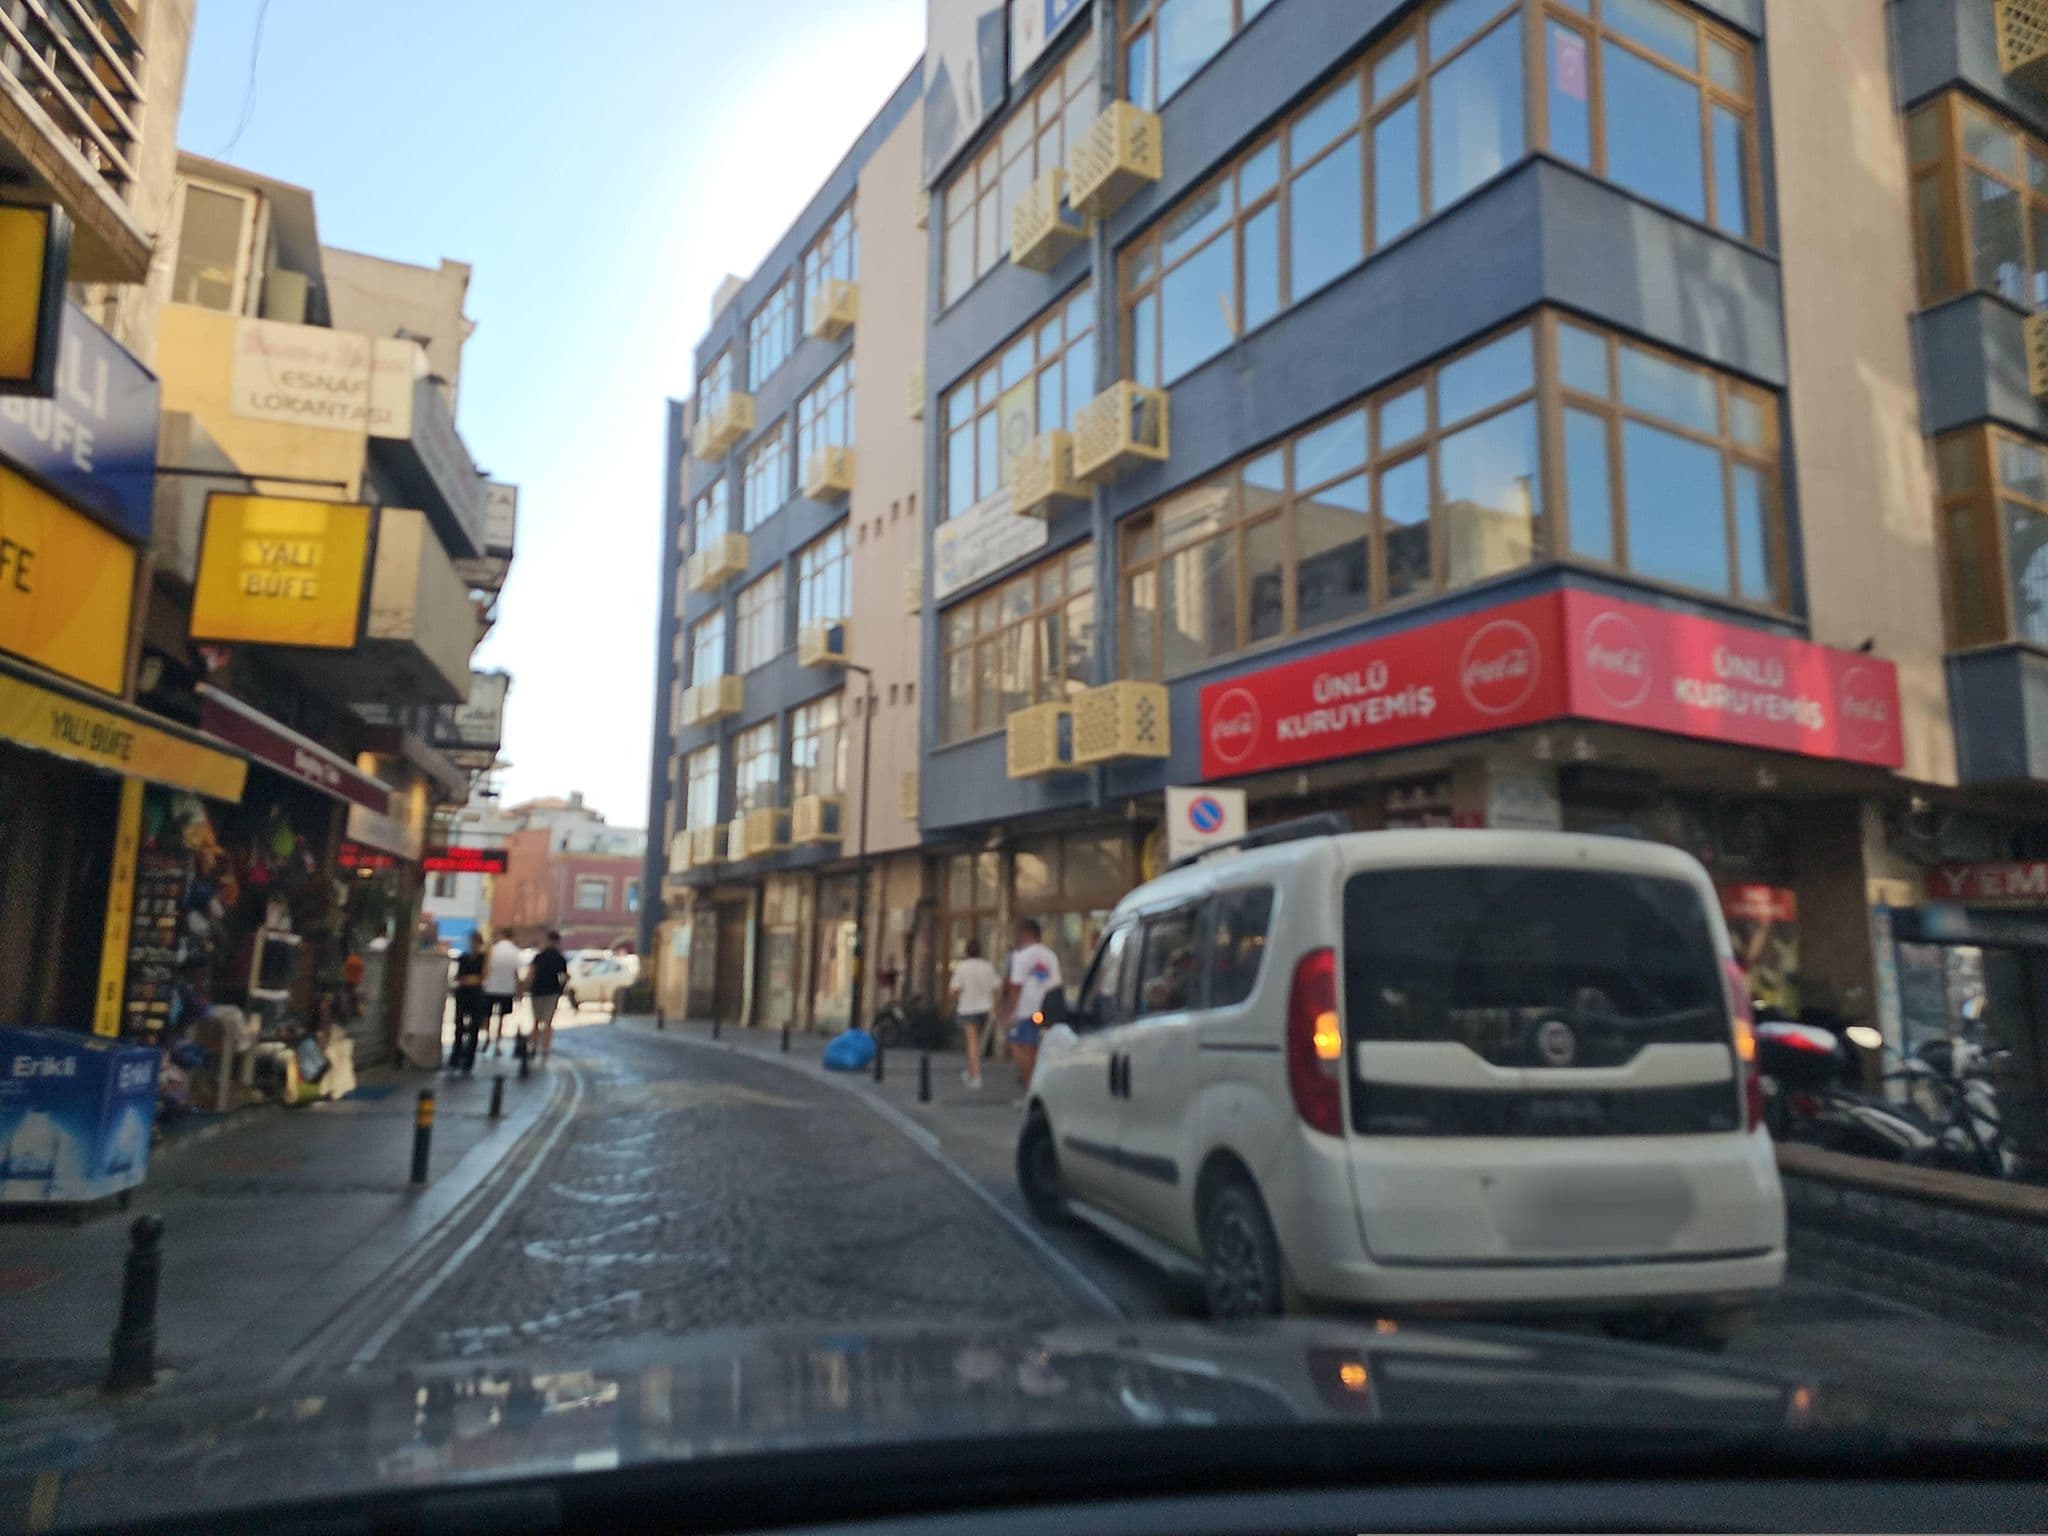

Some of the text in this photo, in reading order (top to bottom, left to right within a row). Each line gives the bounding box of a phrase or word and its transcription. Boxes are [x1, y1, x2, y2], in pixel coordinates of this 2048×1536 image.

[1313, 660, 1388, 703] ÜNLÜ
[1713, 646, 1784, 688] ÜNLÜ
[1276, 684, 1437, 742] KURUYEMİŞ
